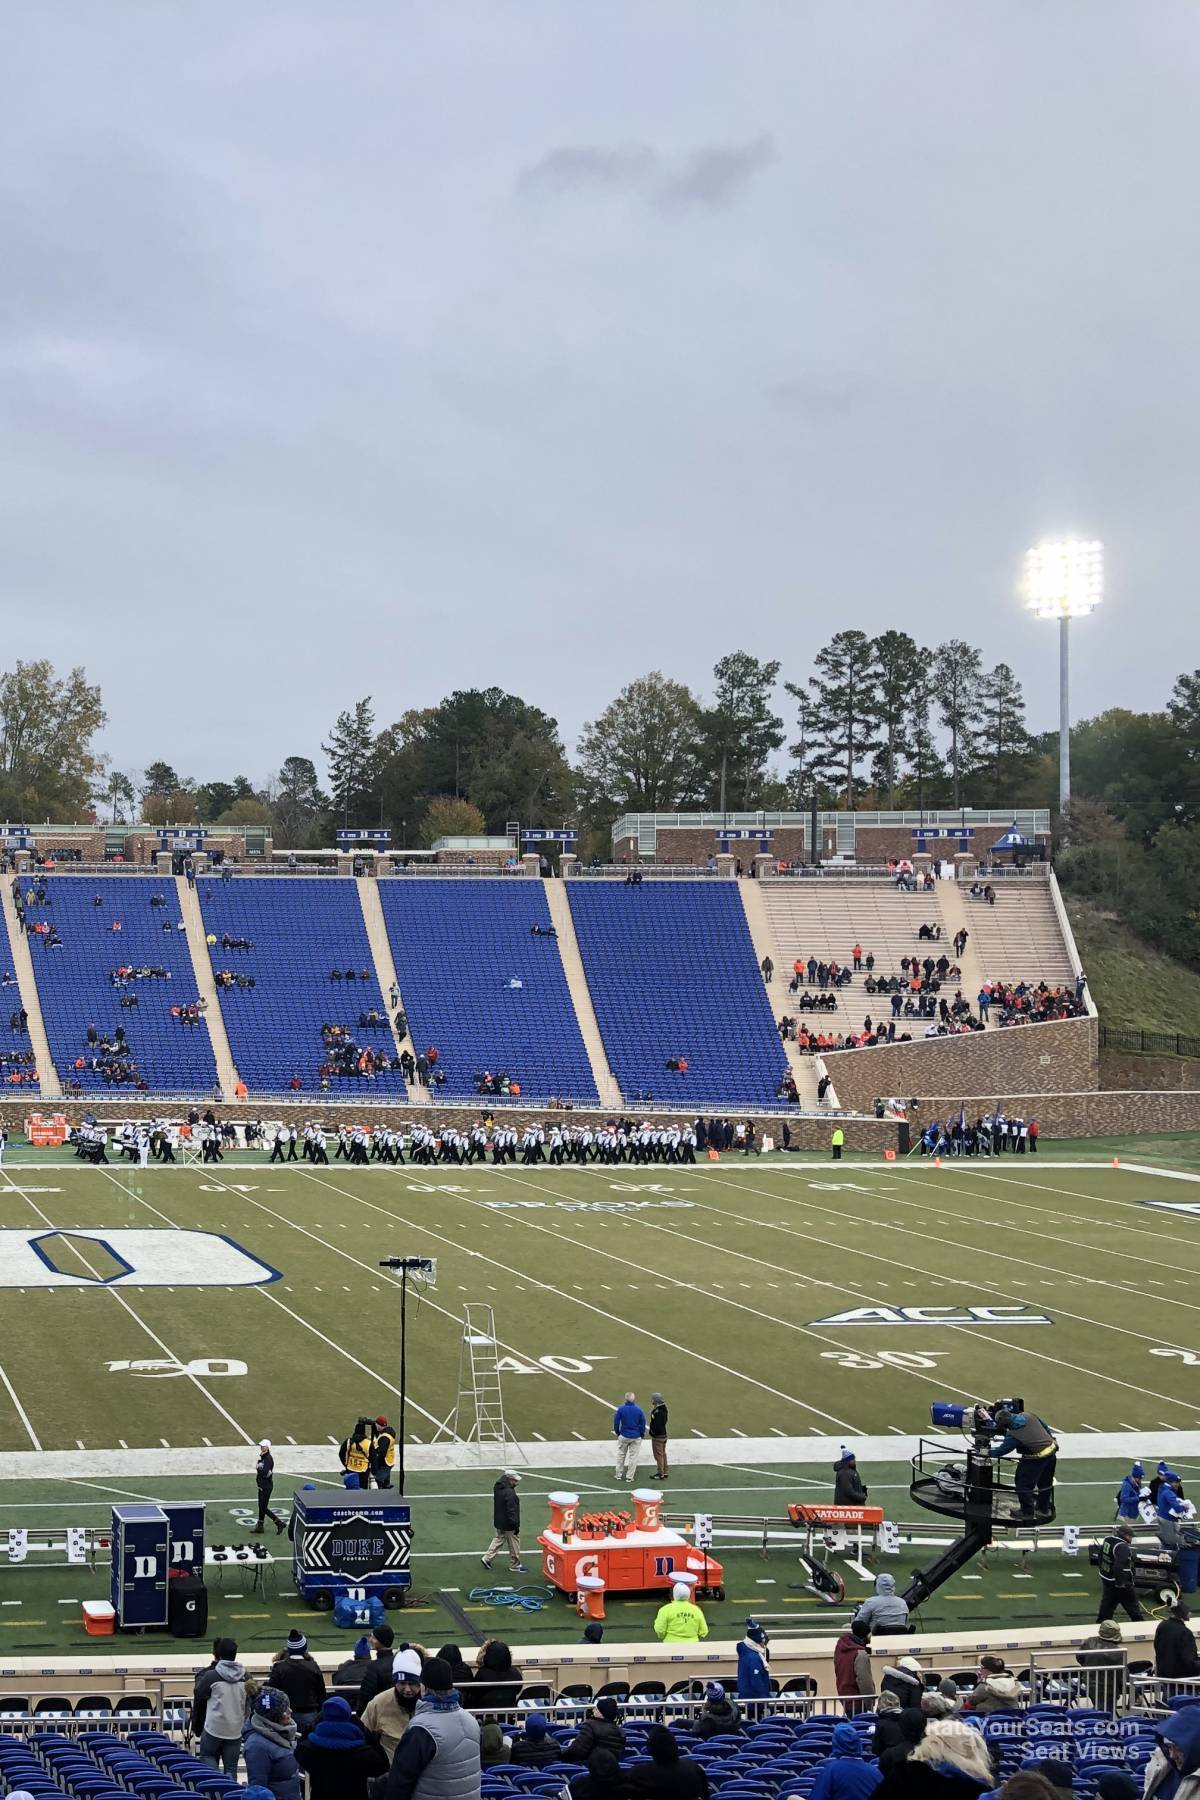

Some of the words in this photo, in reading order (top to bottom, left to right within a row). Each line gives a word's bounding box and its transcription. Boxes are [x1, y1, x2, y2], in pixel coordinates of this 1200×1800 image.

[814, 1306, 1048, 1322] ACC
[493, 1355, 593, 1374] 40
[819, 1351, 938, 1369] 30
[564, 1510, 574, 1520] G
[646, 1506, 656, 1517] G
[171, 1541, 193, 1562] D
[332, 1538, 384, 1556] DUKE
[133, 1556, 156, 1577] D
[546, 1554, 555, 1574] G
[575, 1554, 598, 1577] G
[655, 1556, 674, 1577] D
[185, 1600, 195, 1610] G
[577, 1590, 586, 1602] G
